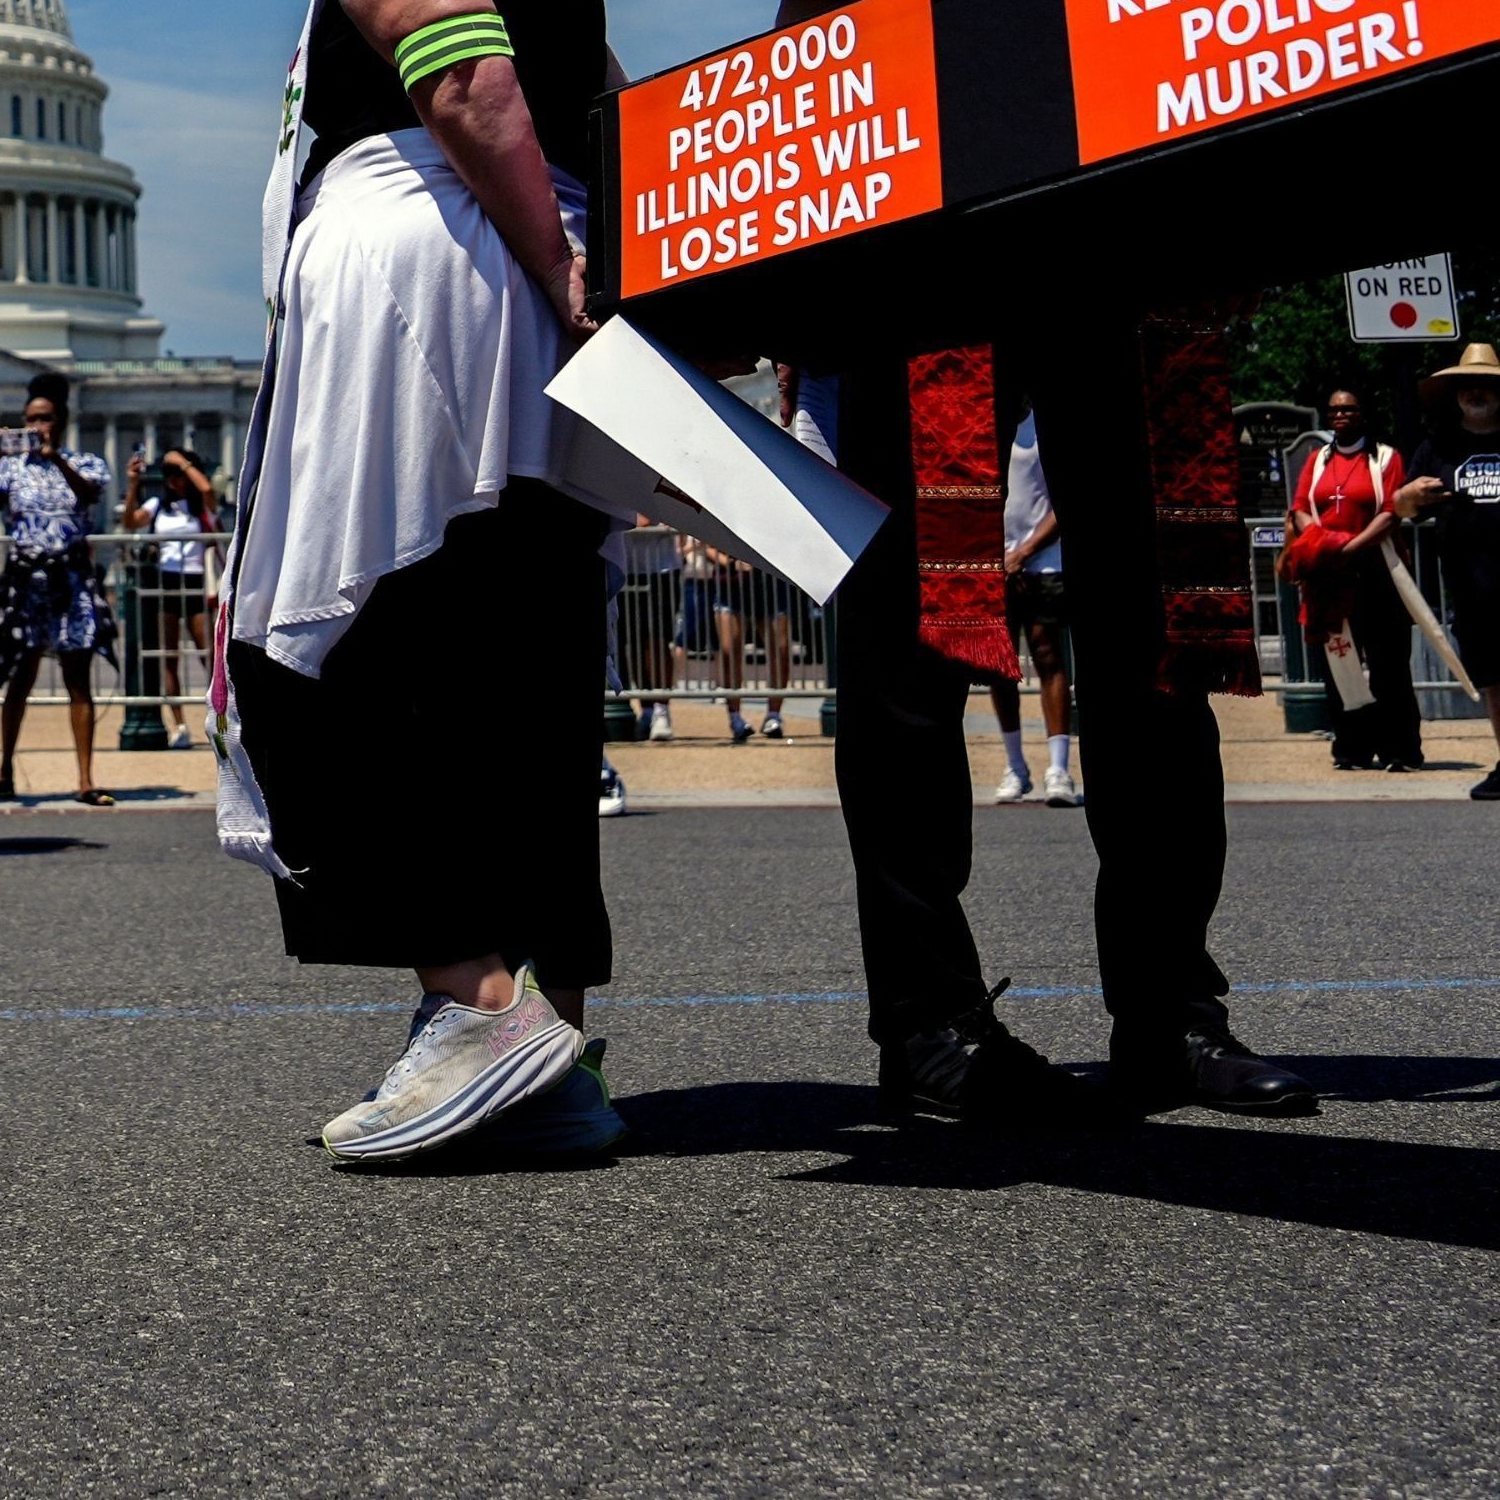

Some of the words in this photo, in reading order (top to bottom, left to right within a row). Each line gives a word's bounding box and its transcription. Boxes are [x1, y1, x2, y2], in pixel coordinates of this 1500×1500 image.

[669, 81, 816, 172] PEOPLE
[829, 61, 874, 118] IN
[679, 14, 856, 112] 472,000
[1157, 0, 1424, 133] MURDER!
[636, 143, 801, 235] ILLINOIS
[811, 107, 921, 177] WILL
[661, 210, 759, 280] LOSE
[772, 171, 892, 246] SNAP
[1357, 277, 1388, 297] ON
[1398, 276, 1442, 296] RED
[486, 998, 549, 1059] HOKA
